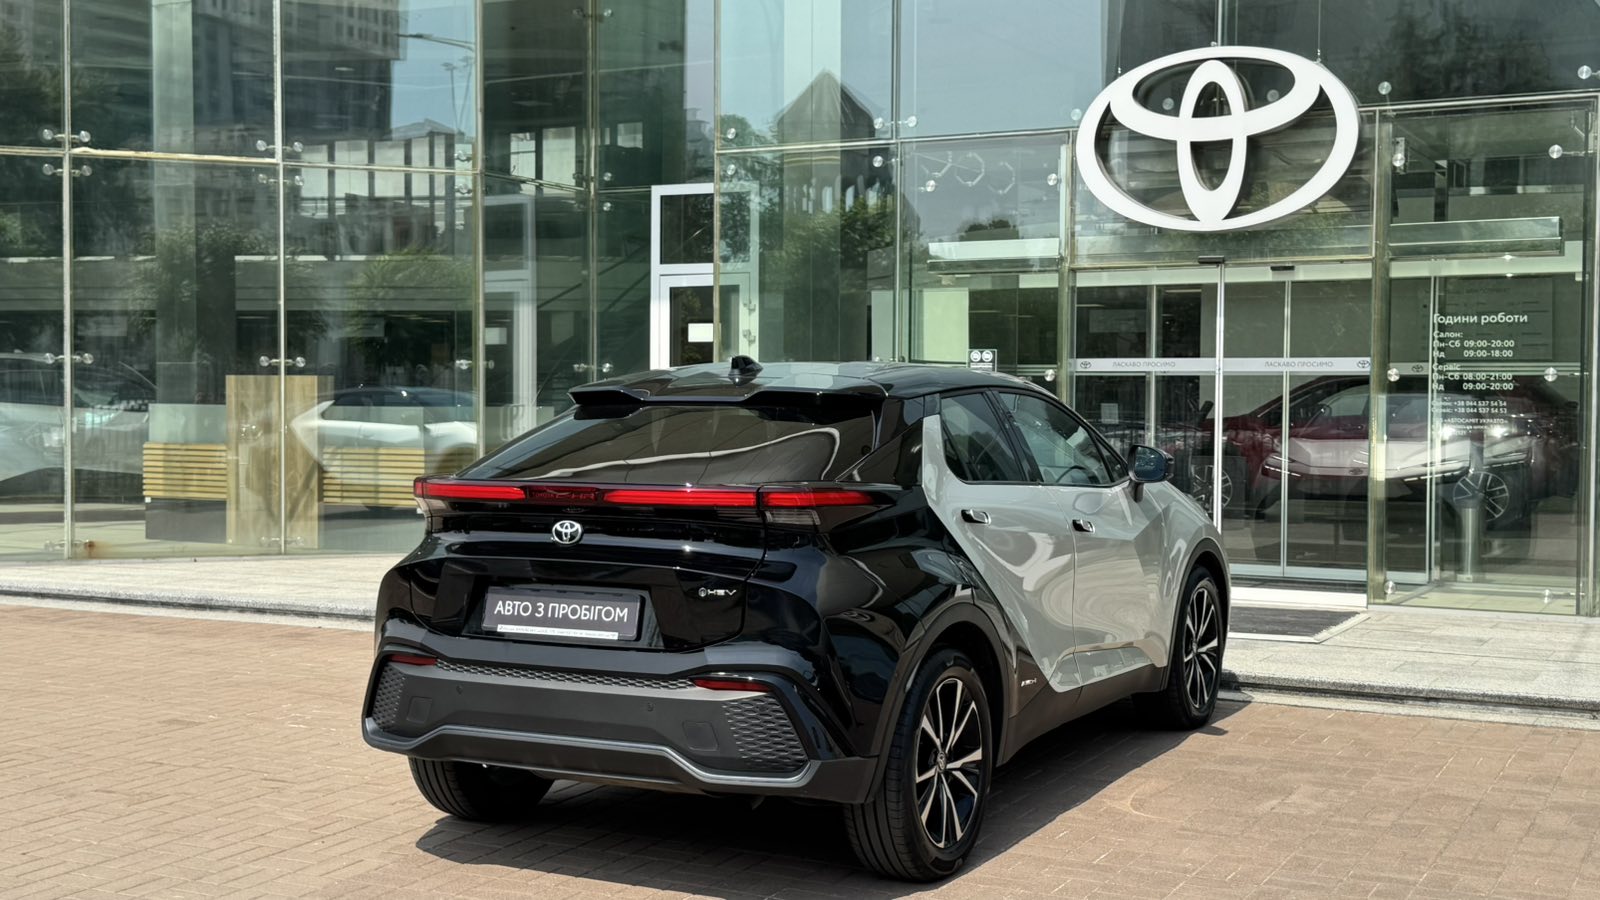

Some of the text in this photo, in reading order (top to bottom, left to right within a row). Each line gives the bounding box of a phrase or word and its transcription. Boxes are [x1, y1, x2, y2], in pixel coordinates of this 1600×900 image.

[1433, 312, 1528, 325] Години роботи
[1433, 340, 1461, 348] Пн-Сб
[1433, 350, 1446, 358] Нд
[494, 600, 532, 616] АВТО
[548, 603, 628, 622] ПРОБІГОМ
